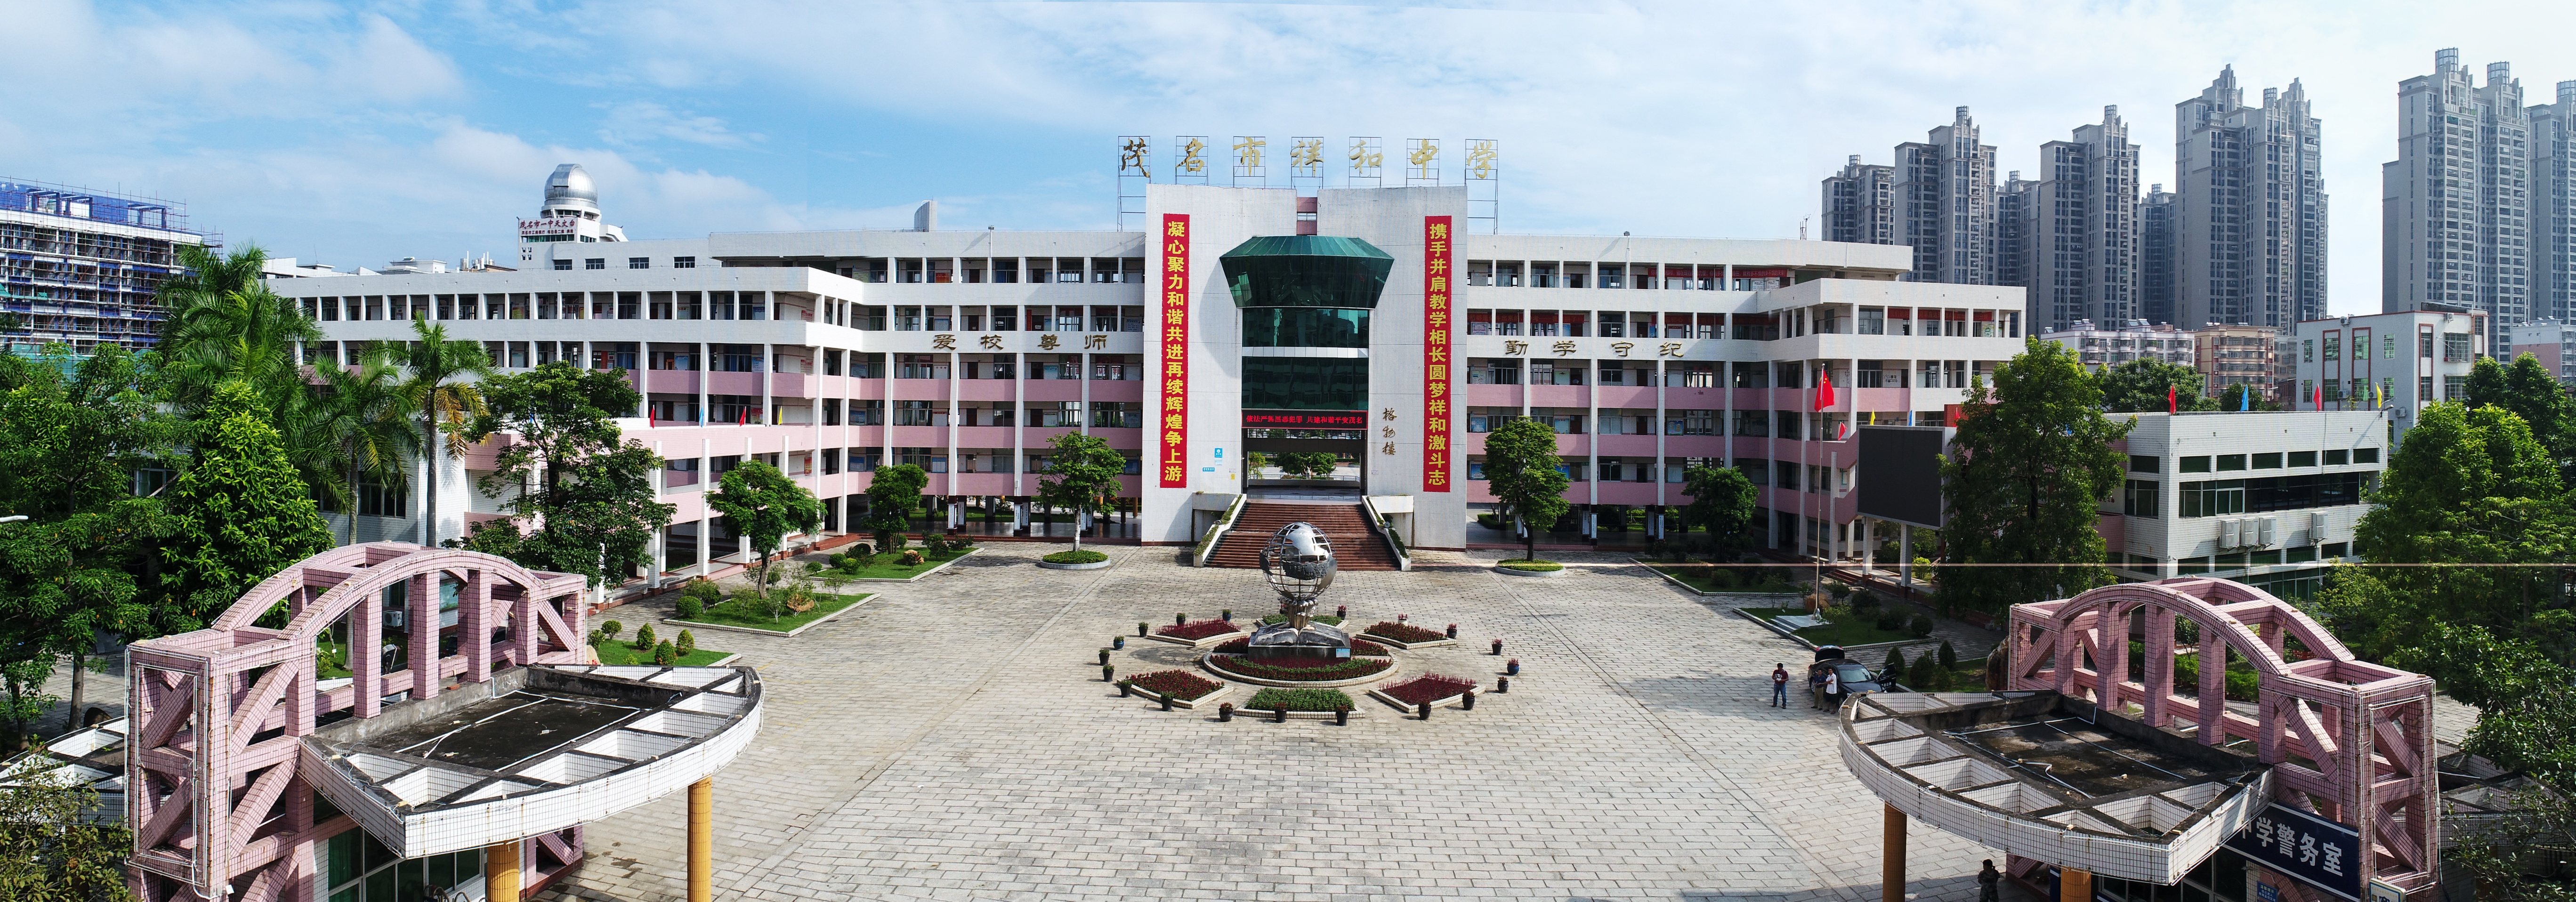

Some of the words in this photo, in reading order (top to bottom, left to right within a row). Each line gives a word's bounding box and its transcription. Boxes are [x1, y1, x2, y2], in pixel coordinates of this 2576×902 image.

[1121, 136, 1497, 179] 茂名市祥和中学
[520, 219, 575, 229] 茂名市一中天文台
[933, 334, 1107, 350] 爱校尊师
[1164, 220, 1186, 482] 凝心聚力和谐共进再续辉煌争上游
[1505, 339, 1684, 357] 勤学守纪
[1428, 223, 1448, 485] 携手并肩教学相长圆梦祥和激斗志
[1307, 416, 1363, 424] 共建和谐平安茂名
